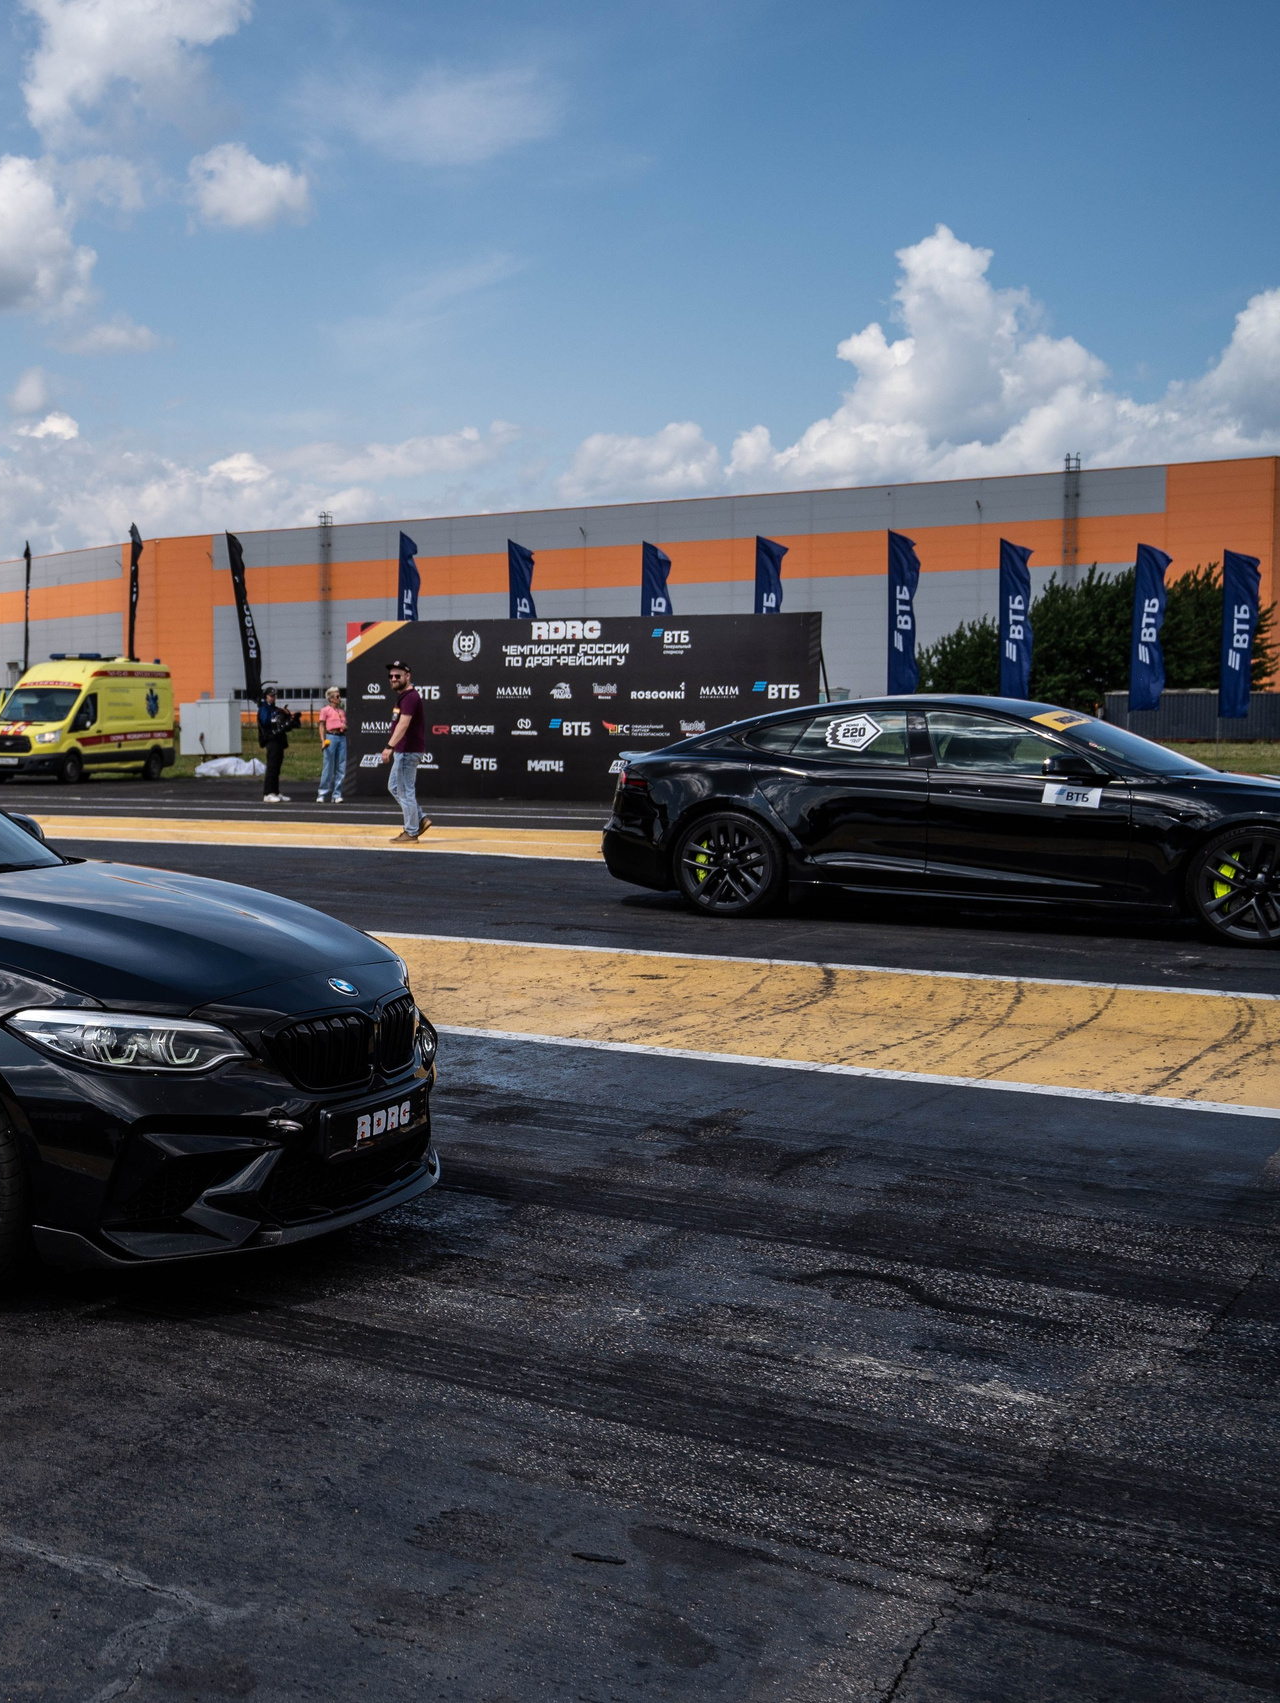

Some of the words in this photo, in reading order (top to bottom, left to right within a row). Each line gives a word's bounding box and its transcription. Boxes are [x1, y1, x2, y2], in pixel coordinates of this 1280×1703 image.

[896, 585, 912, 631] ВТБ
[1009, 594, 1024, 640] ВТБ
[1141, 597, 1159, 643] ВТБ
[1234, 603, 1250, 649] ВТБ
[663, 630, 690, 644] ВТБ
[502, 644, 576, 656] ЧЕМПИОНАТ
[579, 643, 629, 655] РОССИИ
[505, 656, 522, 667] ПО
[525, 653, 625, 668] ДРЭГ-РЕЙСИНГУ
[496, 686, 532, 696] MAXIM
[630, 690, 685, 700] ROSGONKI
[699, 685, 739, 696] MAXIM
[767, 684, 800, 700] ВТБ
[562, 721, 591, 736] ВТБ
[842, 727, 867, 738] 220
[473, 758, 497, 770] ВТБ
[527, 760, 564, 772] МАТЧ!
[1066, 791, 1089, 803] ВТБ
